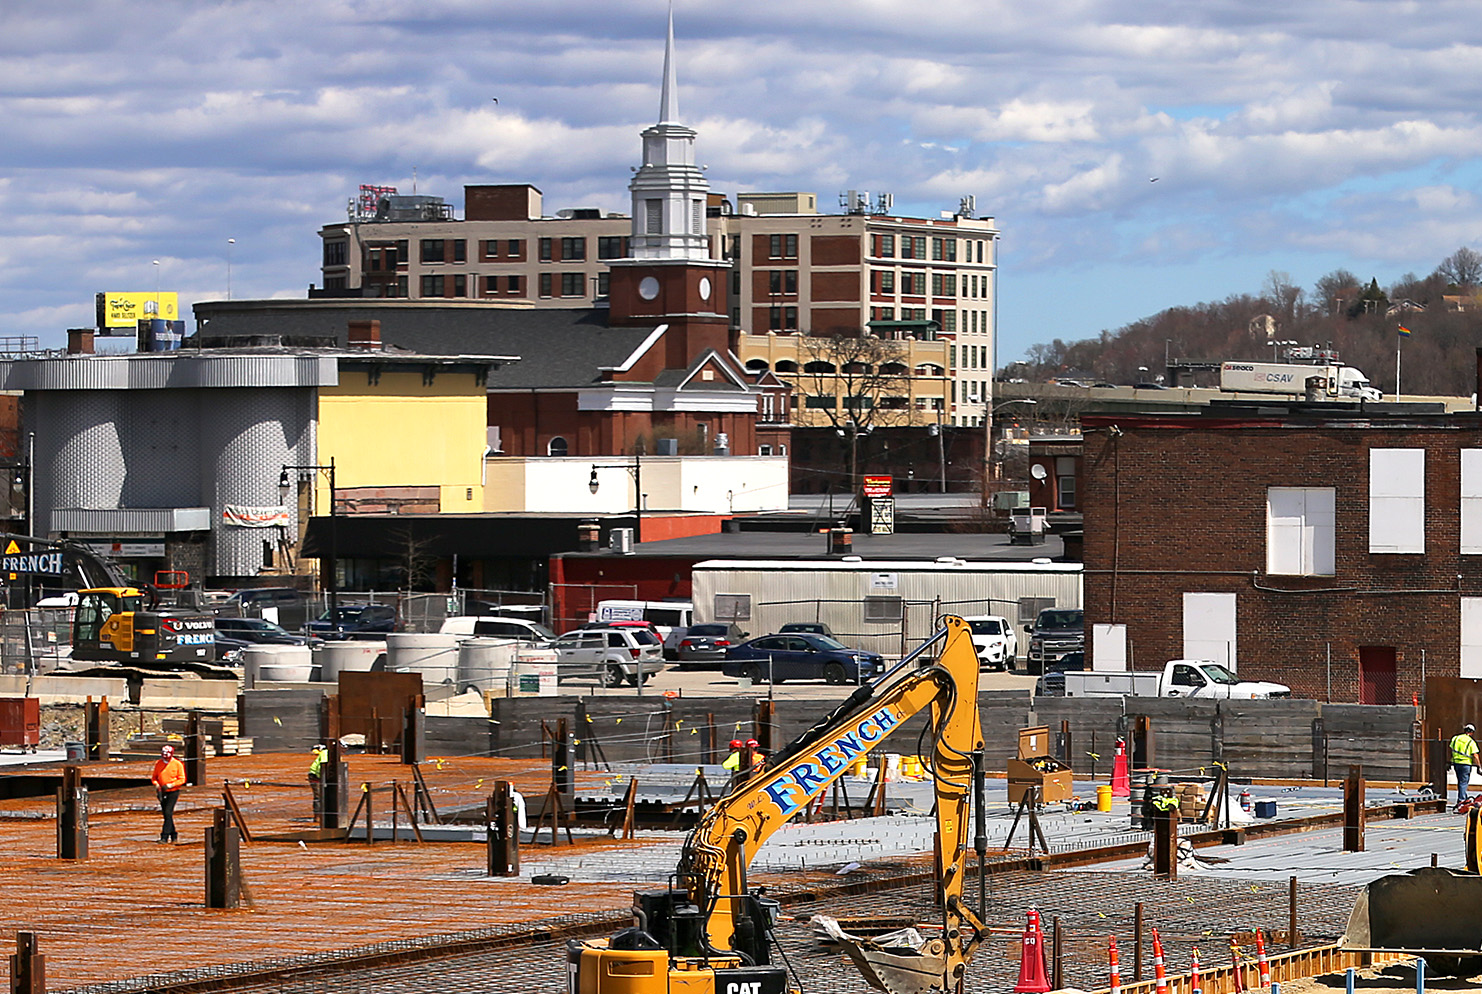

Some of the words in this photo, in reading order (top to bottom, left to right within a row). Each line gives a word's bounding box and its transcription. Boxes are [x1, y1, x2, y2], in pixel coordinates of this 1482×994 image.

[1266, 373, 1294, 383] CSAV
[2, 552, 63, 574] FRENCH
[758, 706, 899, 815] FRENCH
